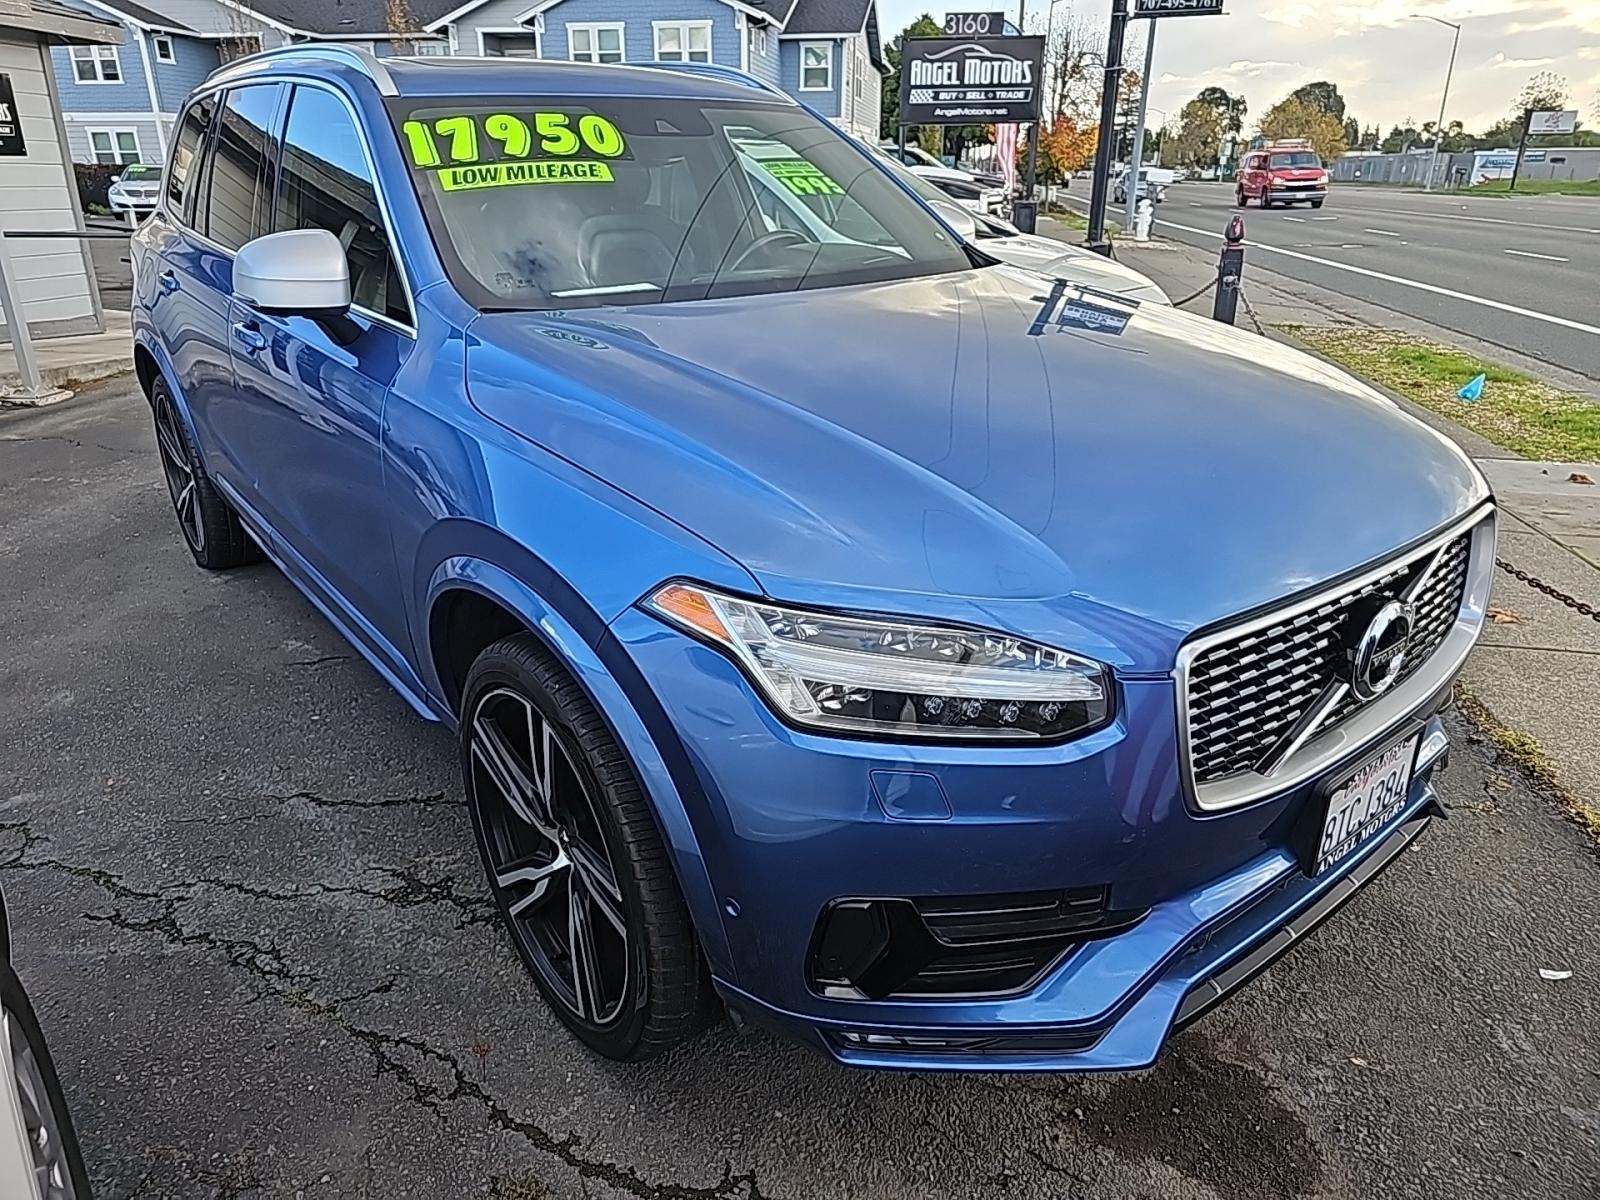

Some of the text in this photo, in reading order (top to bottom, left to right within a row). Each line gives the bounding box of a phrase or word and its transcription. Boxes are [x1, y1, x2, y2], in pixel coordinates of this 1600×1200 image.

[945, 13, 990, 34] 3160
[910, 59, 1033, 86] ANGEL MOTORS
[939, 90, 1025, 100] BUY SELL TRADE
[402, 112, 626, 168] 17950
[451, 163, 600, 187] LOW MILEAGE
[1317, 840, 1360, 876] ANGEL
